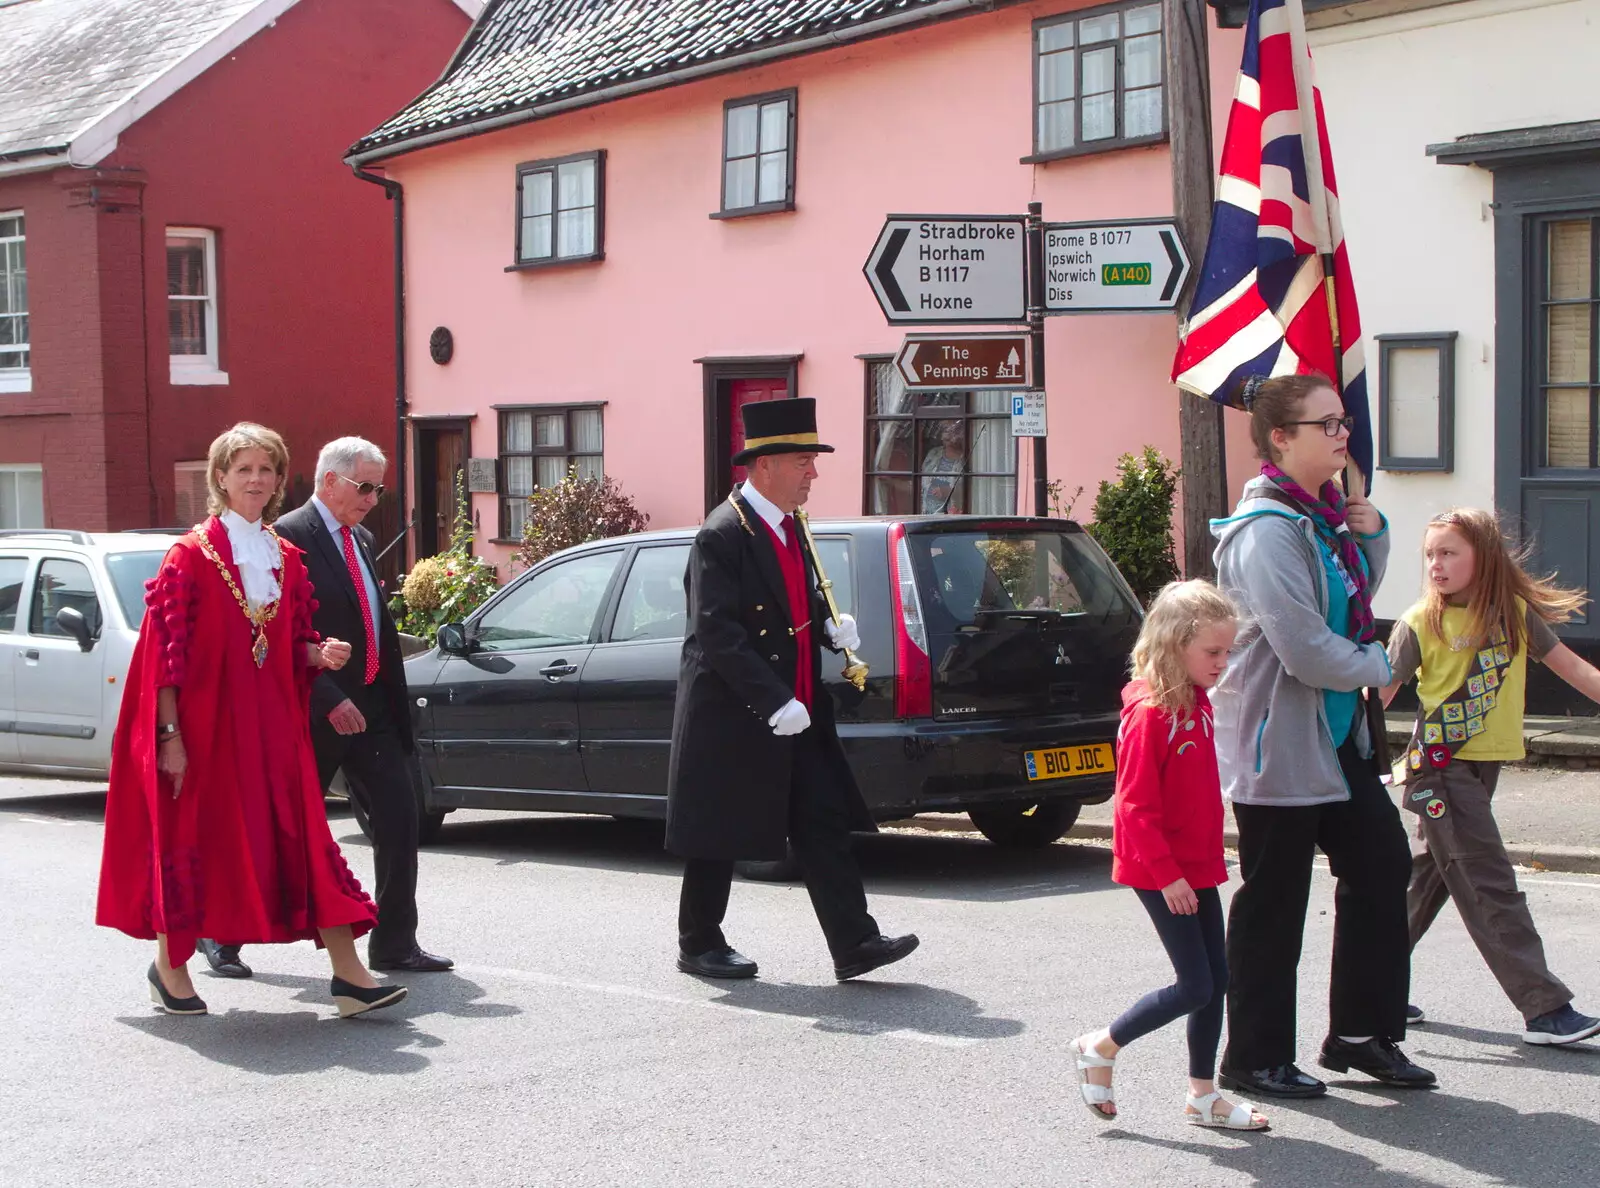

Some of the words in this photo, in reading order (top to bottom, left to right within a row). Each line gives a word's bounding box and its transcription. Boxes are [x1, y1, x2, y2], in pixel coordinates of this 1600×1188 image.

[919, 223, 1015, 240] Stradbroke
[1048, 234, 1085, 248] Brome
[919, 245, 985, 261] Horham
[1048, 252, 1093, 268] Ipswich
[1048, 269, 1096, 283] Norwich
[920, 294, 973, 310] Hoxne
[1048, 287, 1073, 301] Diss
[942, 346, 970, 360] The
[923, 364, 989, 380] Pennings
[1015, 399, 1022, 414] P
[1075, 747, 1105, 770] JDC
